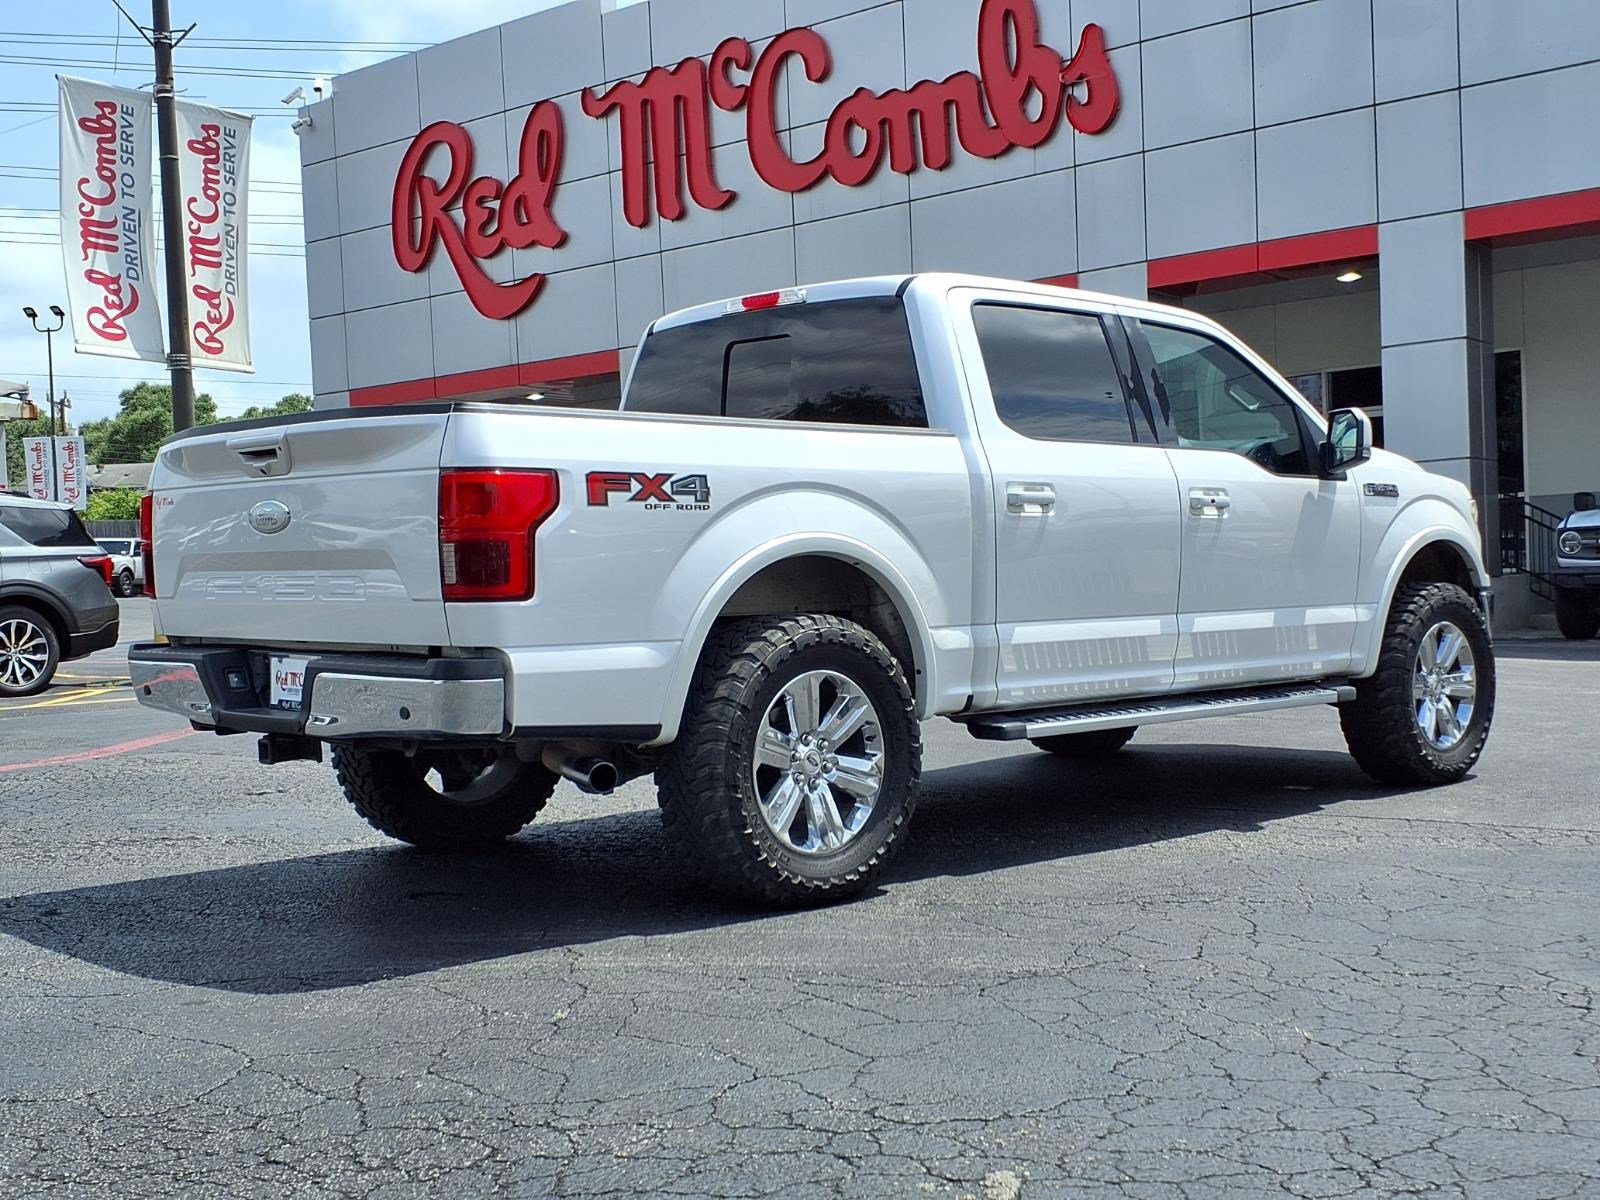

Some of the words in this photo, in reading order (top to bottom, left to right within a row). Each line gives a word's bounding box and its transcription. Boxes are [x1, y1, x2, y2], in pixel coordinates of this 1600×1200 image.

[120, 103, 135, 168] SERVE
[223, 126, 237, 187] SERVE
[392, 100, 568, 321] Red
[581, 0, 1121, 229] McCombs
[76, 100, 120, 262] McCombs
[120, 172, 136, 200] TO
[187, 123, 223, 278] McCombs
[222, 190, 237, 217] TO
[120, 206, 141, 282] DRIVEN
[223, 222, 237, 297] DRIVEN
[86, 268, 140, 342] Red
[192, 283, 235, 355] Red
[31, 441, 43, 487] McCombs
[62, 440, 75, 485] McCombs
[585, 471, 711, 507] FX4
[644, 503, 672, 511] OFF
